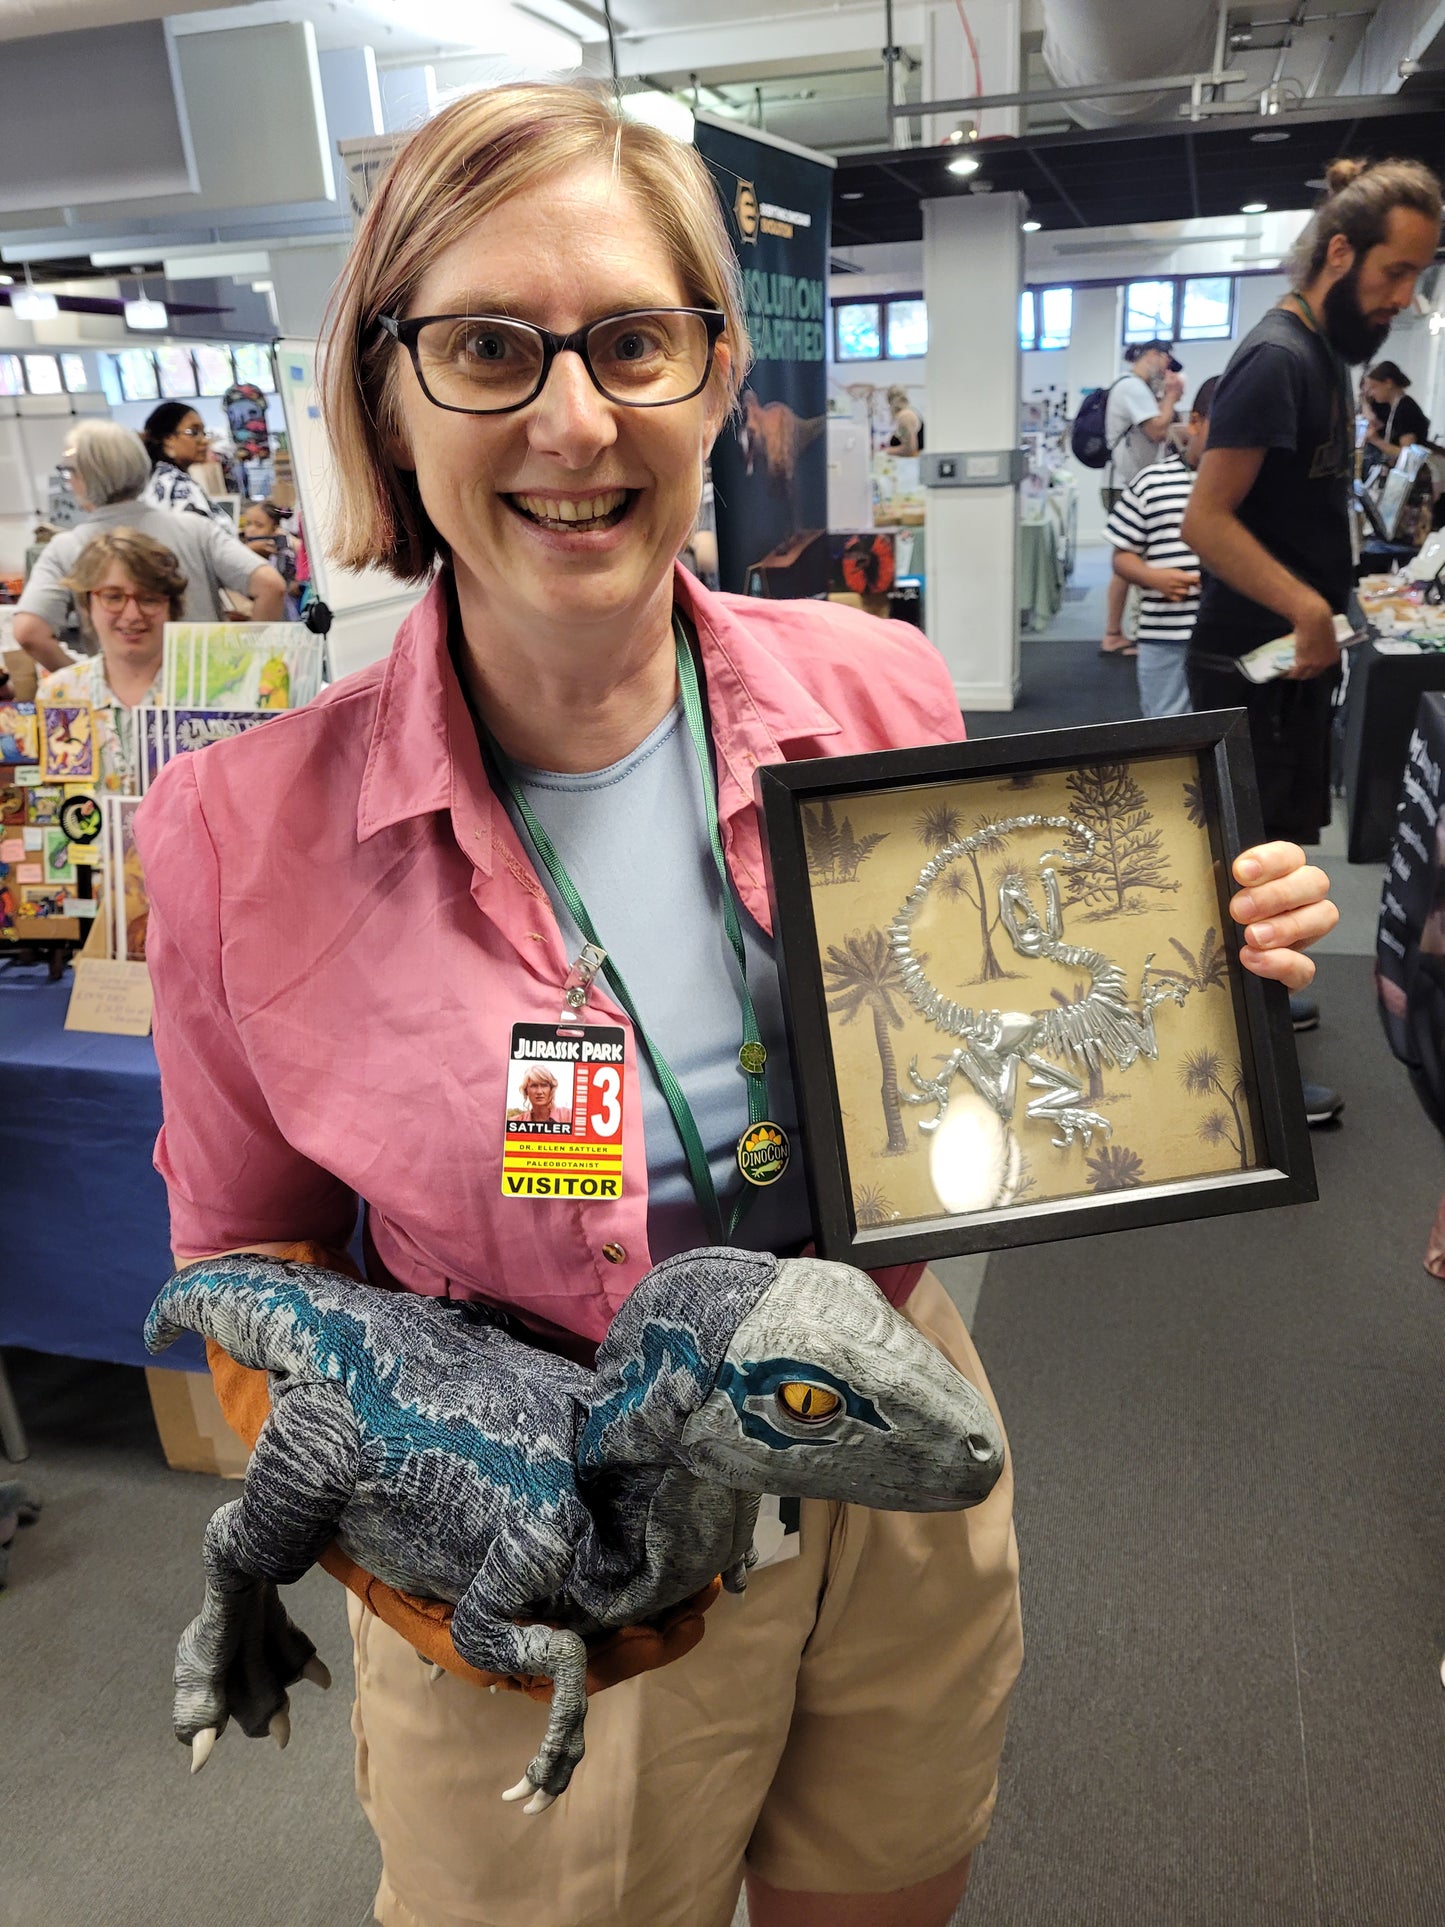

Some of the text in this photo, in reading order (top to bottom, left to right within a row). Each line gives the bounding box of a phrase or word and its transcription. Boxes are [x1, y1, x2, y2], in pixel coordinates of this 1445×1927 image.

[748, 316, 823, 361] EARTHED
[514, 1038, 624, 1062] JURASSIC PARK
[592, 1067, 622, 1137] 3
[509, 1122, 571, 1134] SATTLER
[526, 1160, 600, 1169] PALEOBOTANIST
[507, 1176, 618, 1196] VISITOR
